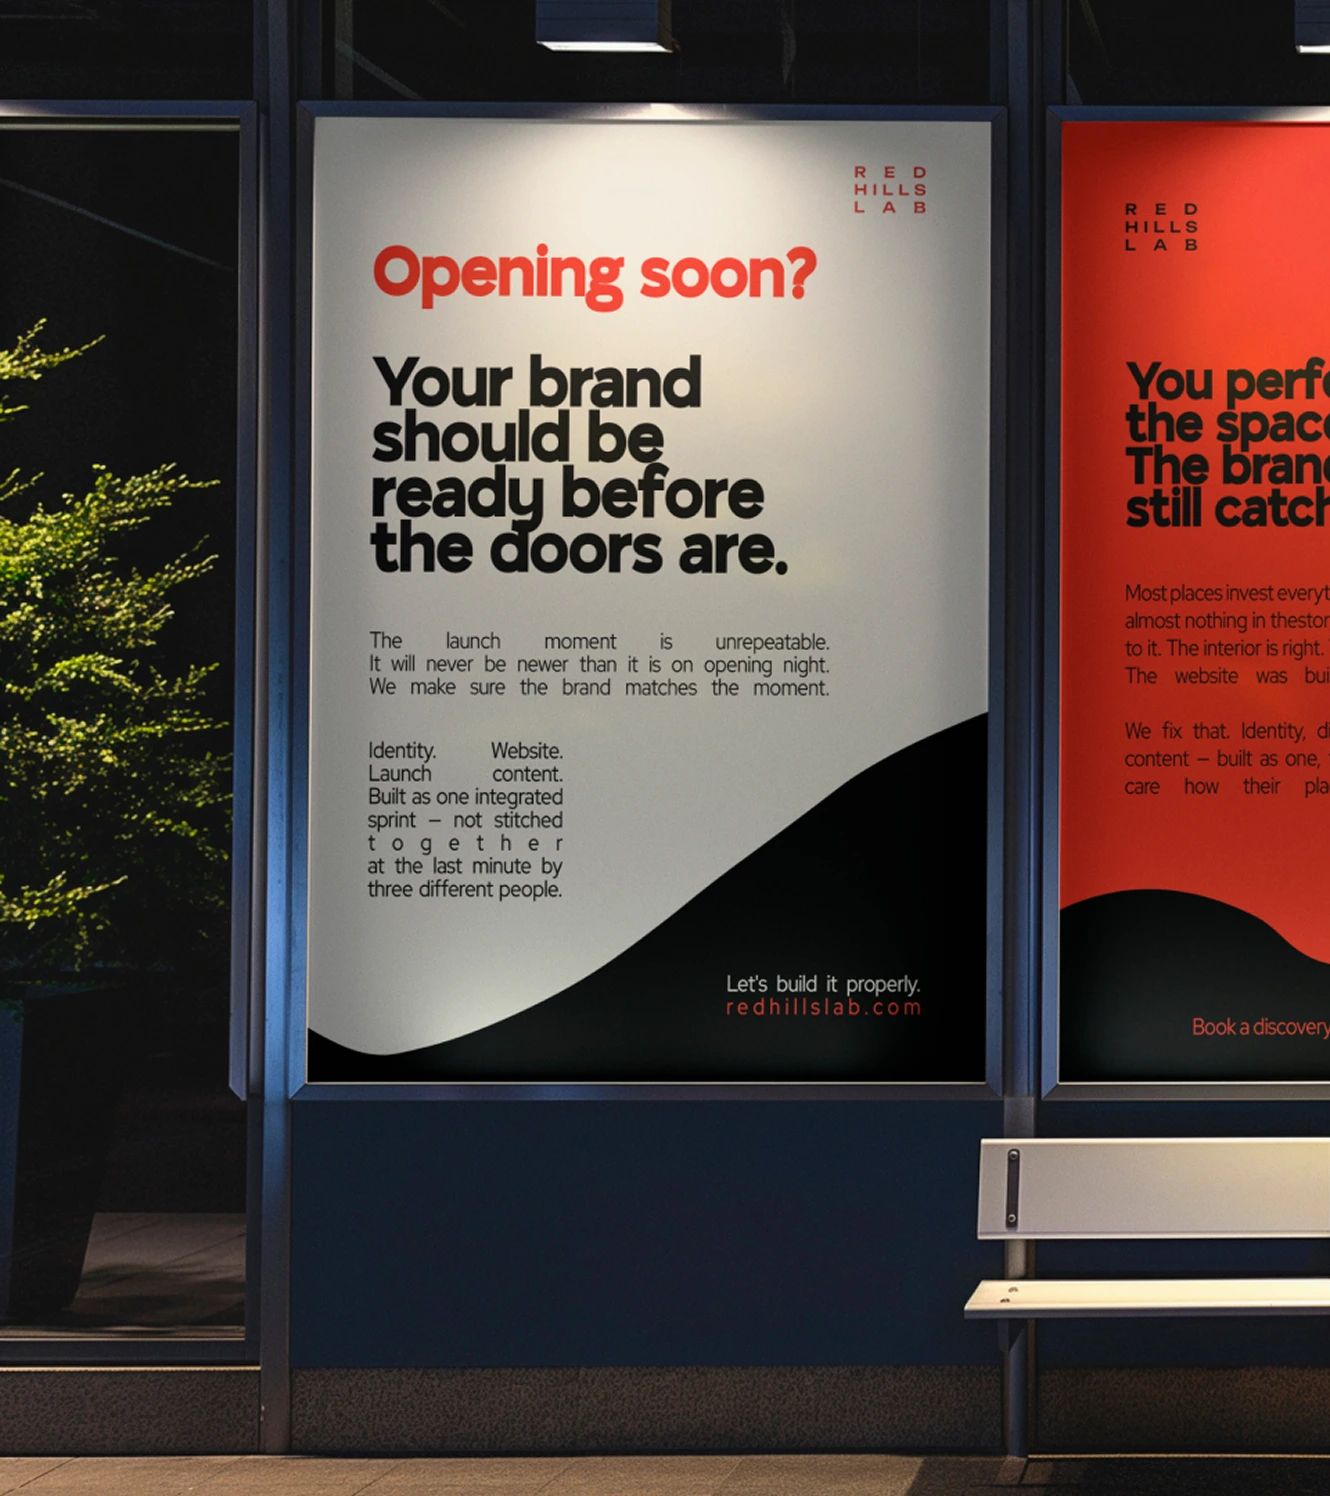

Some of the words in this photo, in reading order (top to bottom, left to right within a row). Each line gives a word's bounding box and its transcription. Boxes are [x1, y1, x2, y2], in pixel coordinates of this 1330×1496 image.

[854, 165, 927, 179] RED
[854, 183, 927, 197] HILLS
[853, 200, 927, 214] LAB
[1125, 202, 1198, 216] RED
[1125, 220, 1198, 234] HILLS
[1125, 238, 1199, 252] LAB
[373, 243, 625, 313] Opening
[639, 245, 818, 300] soon?
[371, 355, 514, 408] Your
[529, 353, 702, 409] brand
[1125, 360, 1213, 401] You
[1124, 401, 1204, 443] the
[371, 407, 570, 464] should
[587, 409, 665, 463] be
[1125, 442, 1210, 485] The
[371, 464, 544, 532] ready
[561, 461, 766, 521] before
[1125, 485, 1202, 528] still
[370, 518, 475, 576] the
[489, 519, 665, 576] doors
[678, 532, 789, 576] are.
[1124, 611, 1181, 630] almost
[1185, 611, 1248, 634] nothing
[1251, 611, 1266, 629] in
[369, 630, 403, 649] The
[446, 631, 501, 650] launch
[544, 633, 618, 650] moment
[660, 632, 673, 651] is
[715, 632, 830, 655] unrepeatable.
[1124, 640, 1143, 657] to
[1147, 639, 1162, 657] it.
[1166, 638, 1200, 657] The
[1203, 639, 1263, 657] interior
[1266, 638, 1279, 657] is
[1282, 639, 1325, 662] right.
[370, 654, 381, 672] It
[390, 654, 416, 672] will
[426, 658, 474, 673] never
[484, 654, 507, 673] be
[517, 658, 569, 673] newer
[579, 654, 618, 673] than
[628, 655, 639, 673] it
[648, 655, 662, 673] is
[671, 659, 694, 673] on
[703, 655, 773, 679] opening
[783, 655, 830, 679] night.
[1124, 666, 1158, 685] The
[1174, 666, 1239, 685] website
[1255, 669, 1289, 685] was
[369, 677, 397, 695] We
[410, 677, 457, 696] make
[469, 681, 506, 696] sure
[519, 677, 549, 696] the
[562, 677, 611, 696] brand
[625, 678, 698, 697] matches
[711, 678, 740, 697] the
[753, 680, 830, 697] moment.
[1124, 721, 1152, 740] We
[1161, 720, 1183, 739] fix
[1192, 721, 1230, 740] that.
[1241, 721, 1307, 744] Identity,
[369, 741, 437, 764] Identity.
[491, 741, 564, 760] Website.
[369, 764, 432, 782] Launch
[492, 766, 564, 783] content.
[1124, 781, 1161, 795] care
[1184, 776, 1220, 795] how
[1242, 776, 1281, 795] their
[368, 787, 407, 805] Built
[411, 791, 432, 806] as
[436, 791, 470, 806] one
[475, 787, 564, 810] integrated
[367, 810, 417, 833] sprint
[453, 811, 483, 829] not
[494, 810, 564, 829] stitched
[367, 833, 564, 856] together
[367, 857, 385, 875] at
[394, 856, 424, 875] the
[433, 856, 463, 875] last
[472, 856, 532, 875] minute
[541, 856, 564, 880] by
[367, 879, 414, 898] three
[418, 878, 494, 898] different
[499, 879, 563, 902] people.
[727, 974, 768, 993] Let's
[776, 974, 818, 993] build
[826, 974, 838, 993] it
[846, 974, 921, 997] properly.
[726, 997, 921, 1016] redhillslab.com
[1192, 1017, 1237, 1036] Book
[1239, 1021, 1250, 1036] a
